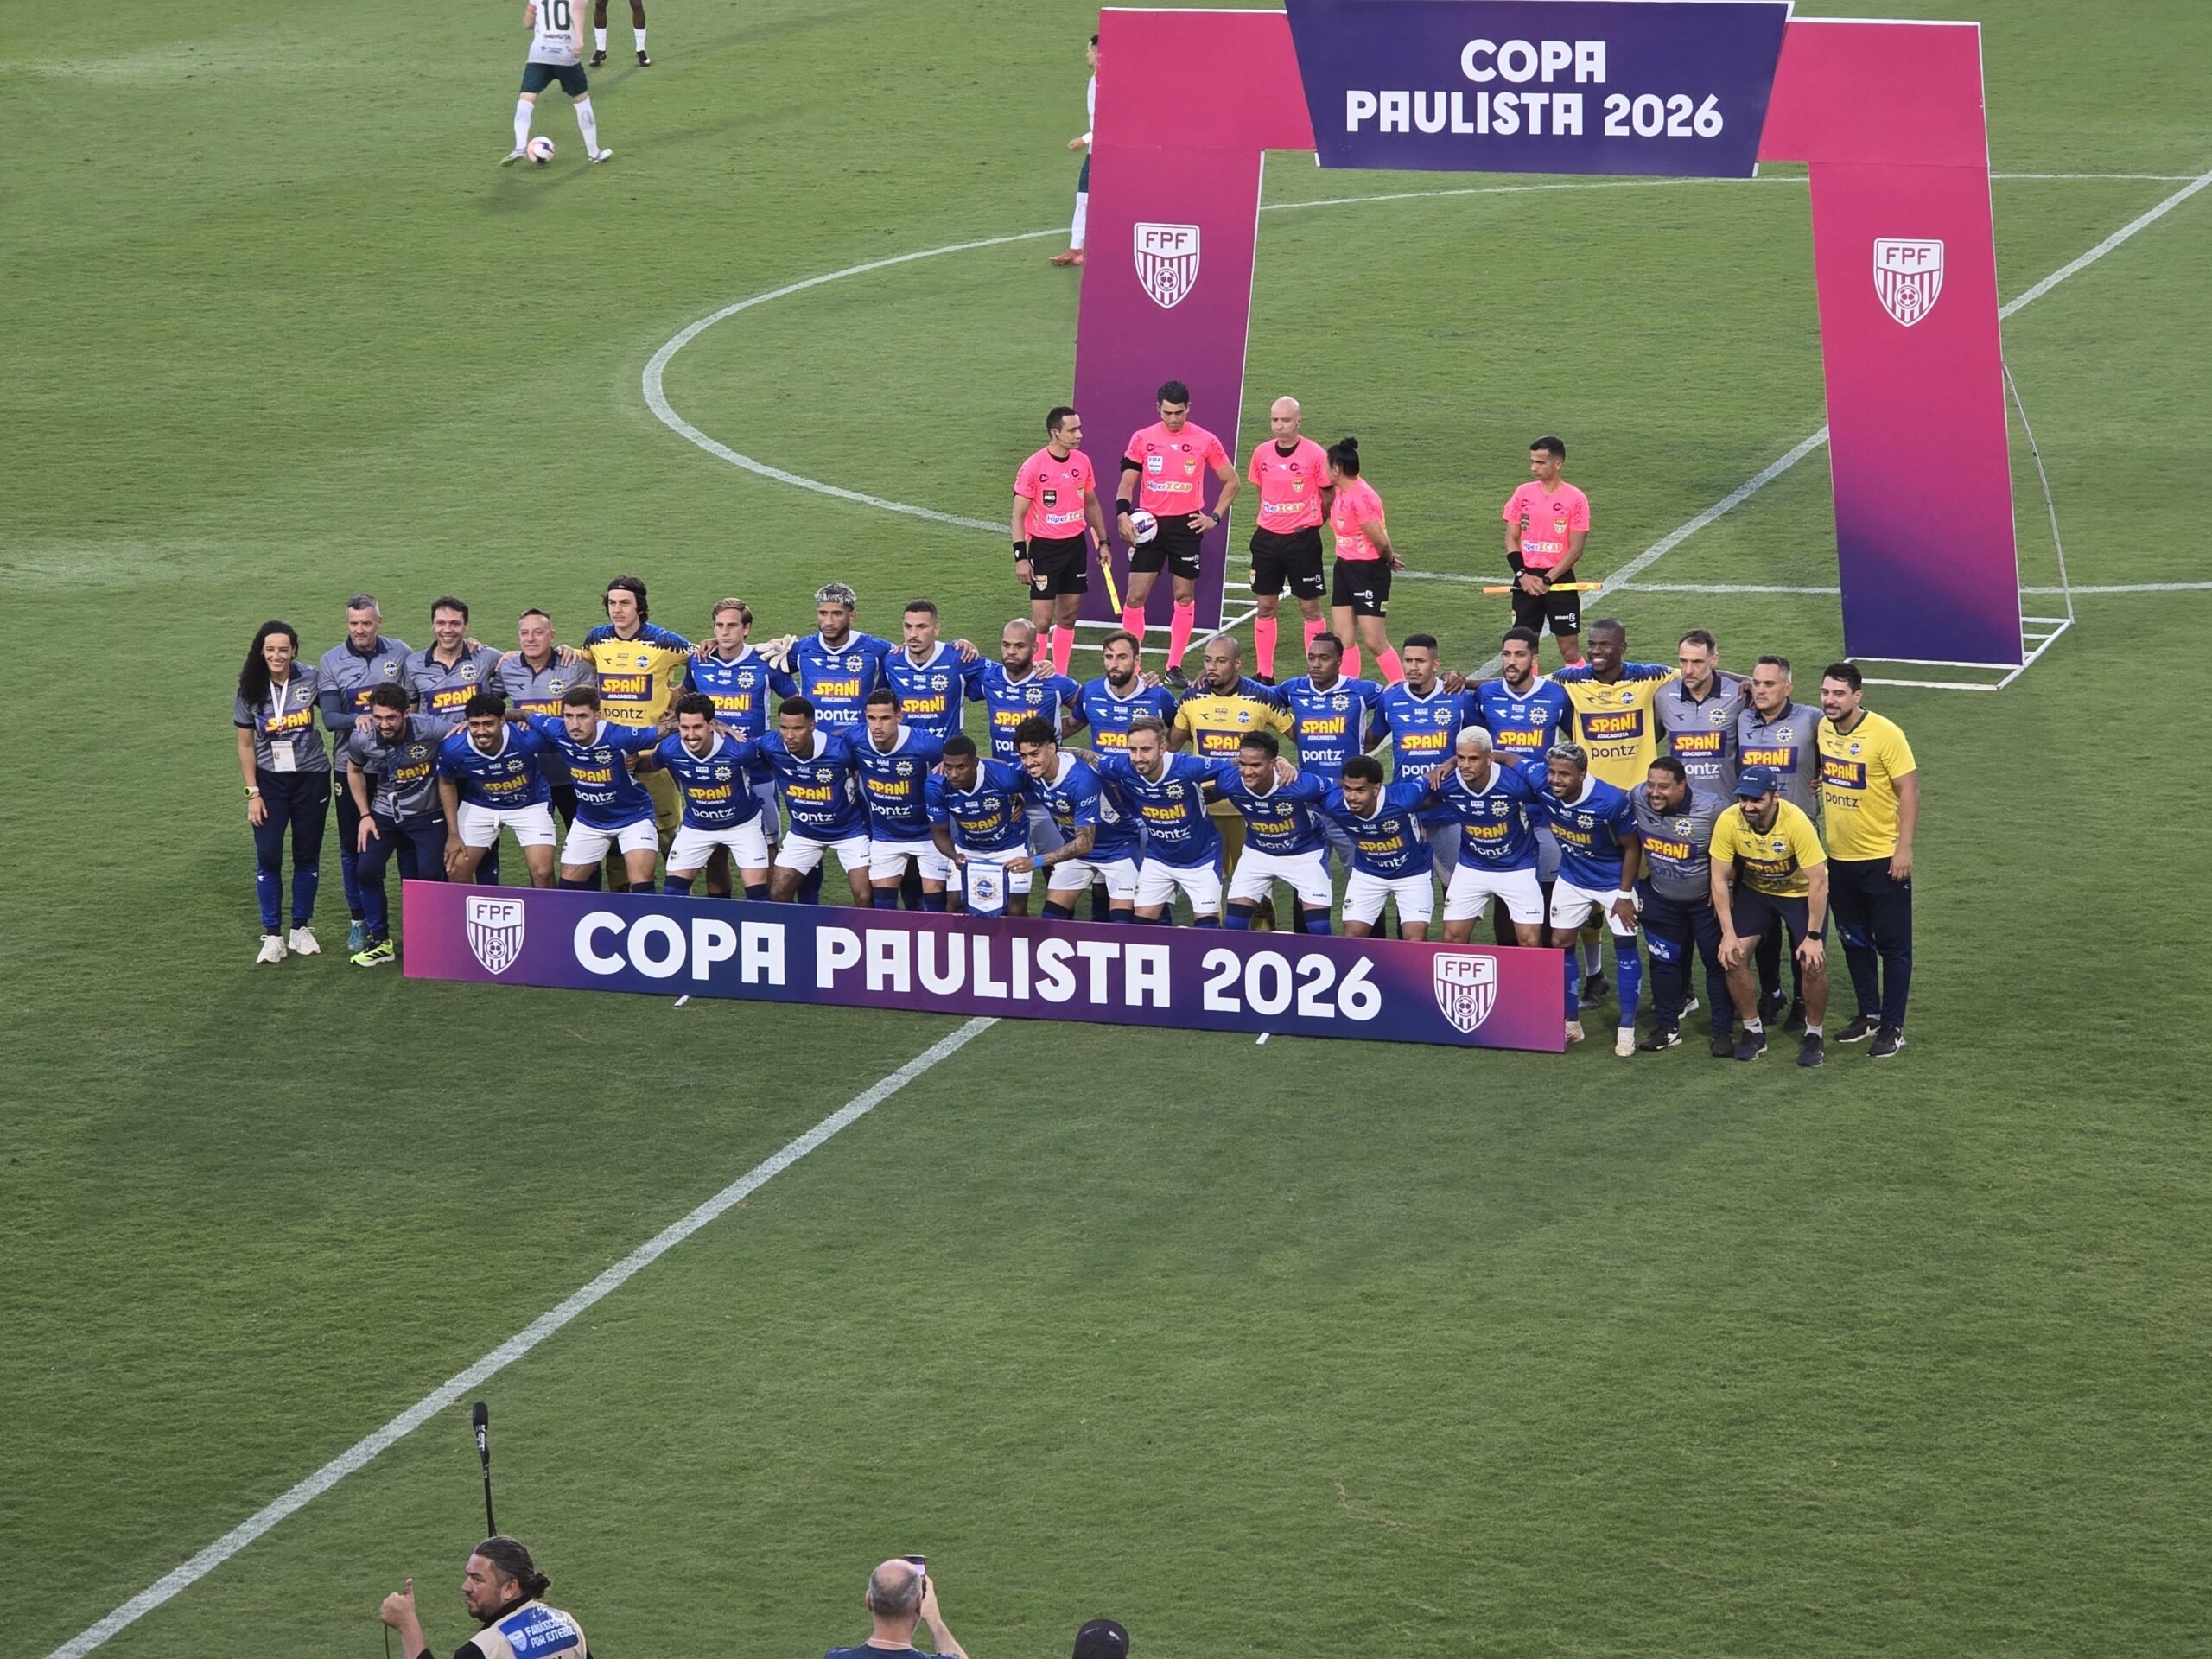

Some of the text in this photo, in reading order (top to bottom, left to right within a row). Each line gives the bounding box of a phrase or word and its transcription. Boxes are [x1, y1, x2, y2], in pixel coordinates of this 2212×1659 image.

[541, 0, 570, 31] 10
[1460, 39, 1605, 83] COPA
[1346, 90, 1723, 137] PAULISTA 2026
[1146, 232, 1188, 249] FPF
[1886, 247, 1931, 265] FPF
[815, 709, 858, 722] pontz
[1302, 749, 1342, 763] pontz
[1592, 745, 1636, 760] pontz
[1685, 762, 1719, 774] ontz
[1826, 791, 1859, 808] pontz
[477, 904, 513, 921] FPF
[574, 911, 1382, 1020] COPA PAULISTA 2026
[1445, 961, 1485, 977] FPF
[531, 1625, 576, 1648] POR FUTEBOL
